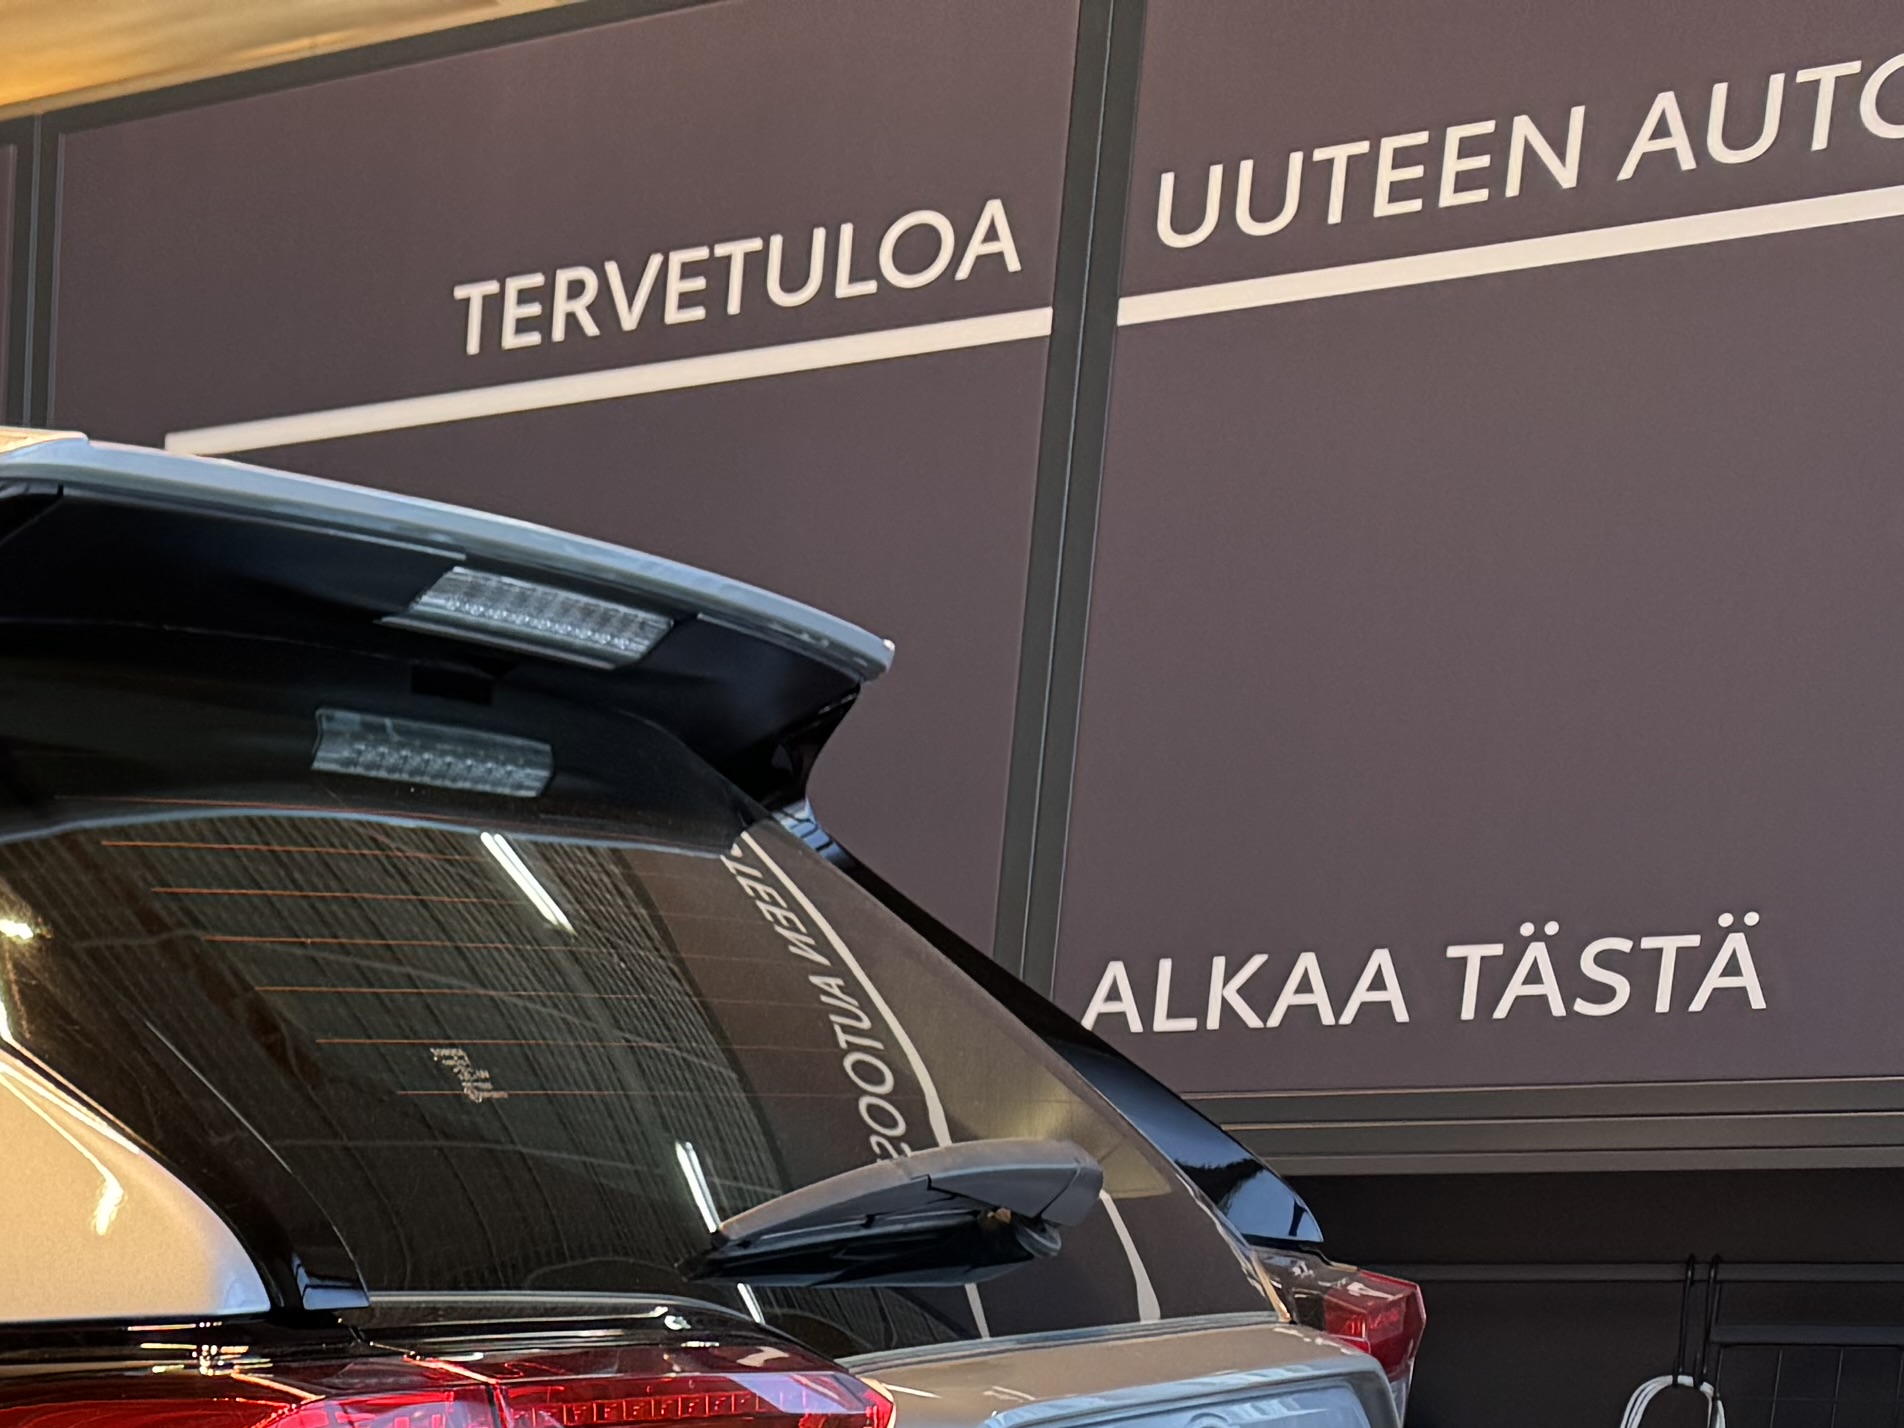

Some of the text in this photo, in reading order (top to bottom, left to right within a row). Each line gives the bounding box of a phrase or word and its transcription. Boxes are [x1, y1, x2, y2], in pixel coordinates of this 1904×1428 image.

[453, 198, 1022, 356] TERVETULOA
[1156, 104, 1585, 249] UUTEEN
[1080, 910, 1767, 1034] ALKAA TÄSTÄ
